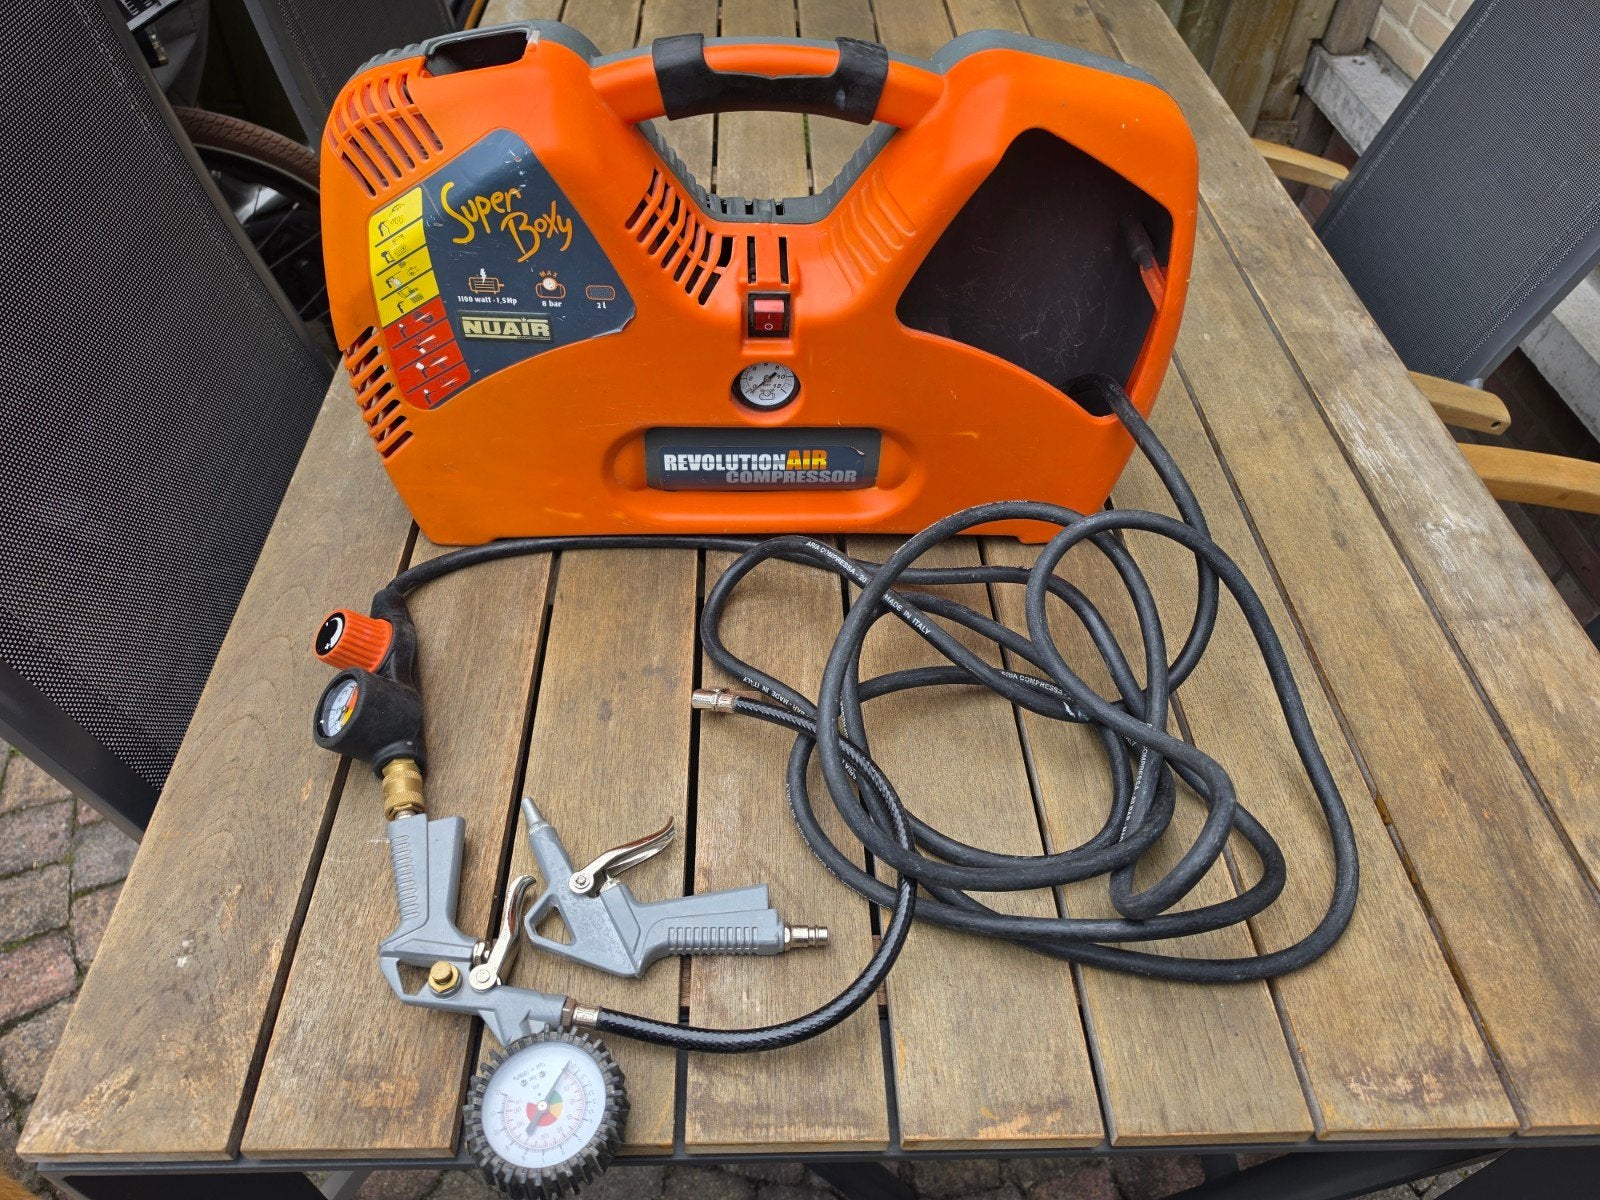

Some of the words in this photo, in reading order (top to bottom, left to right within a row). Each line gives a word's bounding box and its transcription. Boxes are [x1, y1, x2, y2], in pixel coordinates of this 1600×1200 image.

[440, 181, 521, 245] Super
[500, 200, 573, 263] Boxy
[457, 295, 473, 303] 1100
[474, 295, 492, 303] watt
[548, 300, 562, 308] bar
[663, 449, 828, 471] REVOLUTIONAIR
[726, 470, 857, 484] COMPRESSOR
[820, 547, 856, 575] COMPRESSA
[884, 594, 903, 611] MADE
[902, 609, 912, 619] IN
[911, 617, 931, 635] ITALY
[762, 685, 770, 693] IN
[771, 690, 789, 704] MADE
